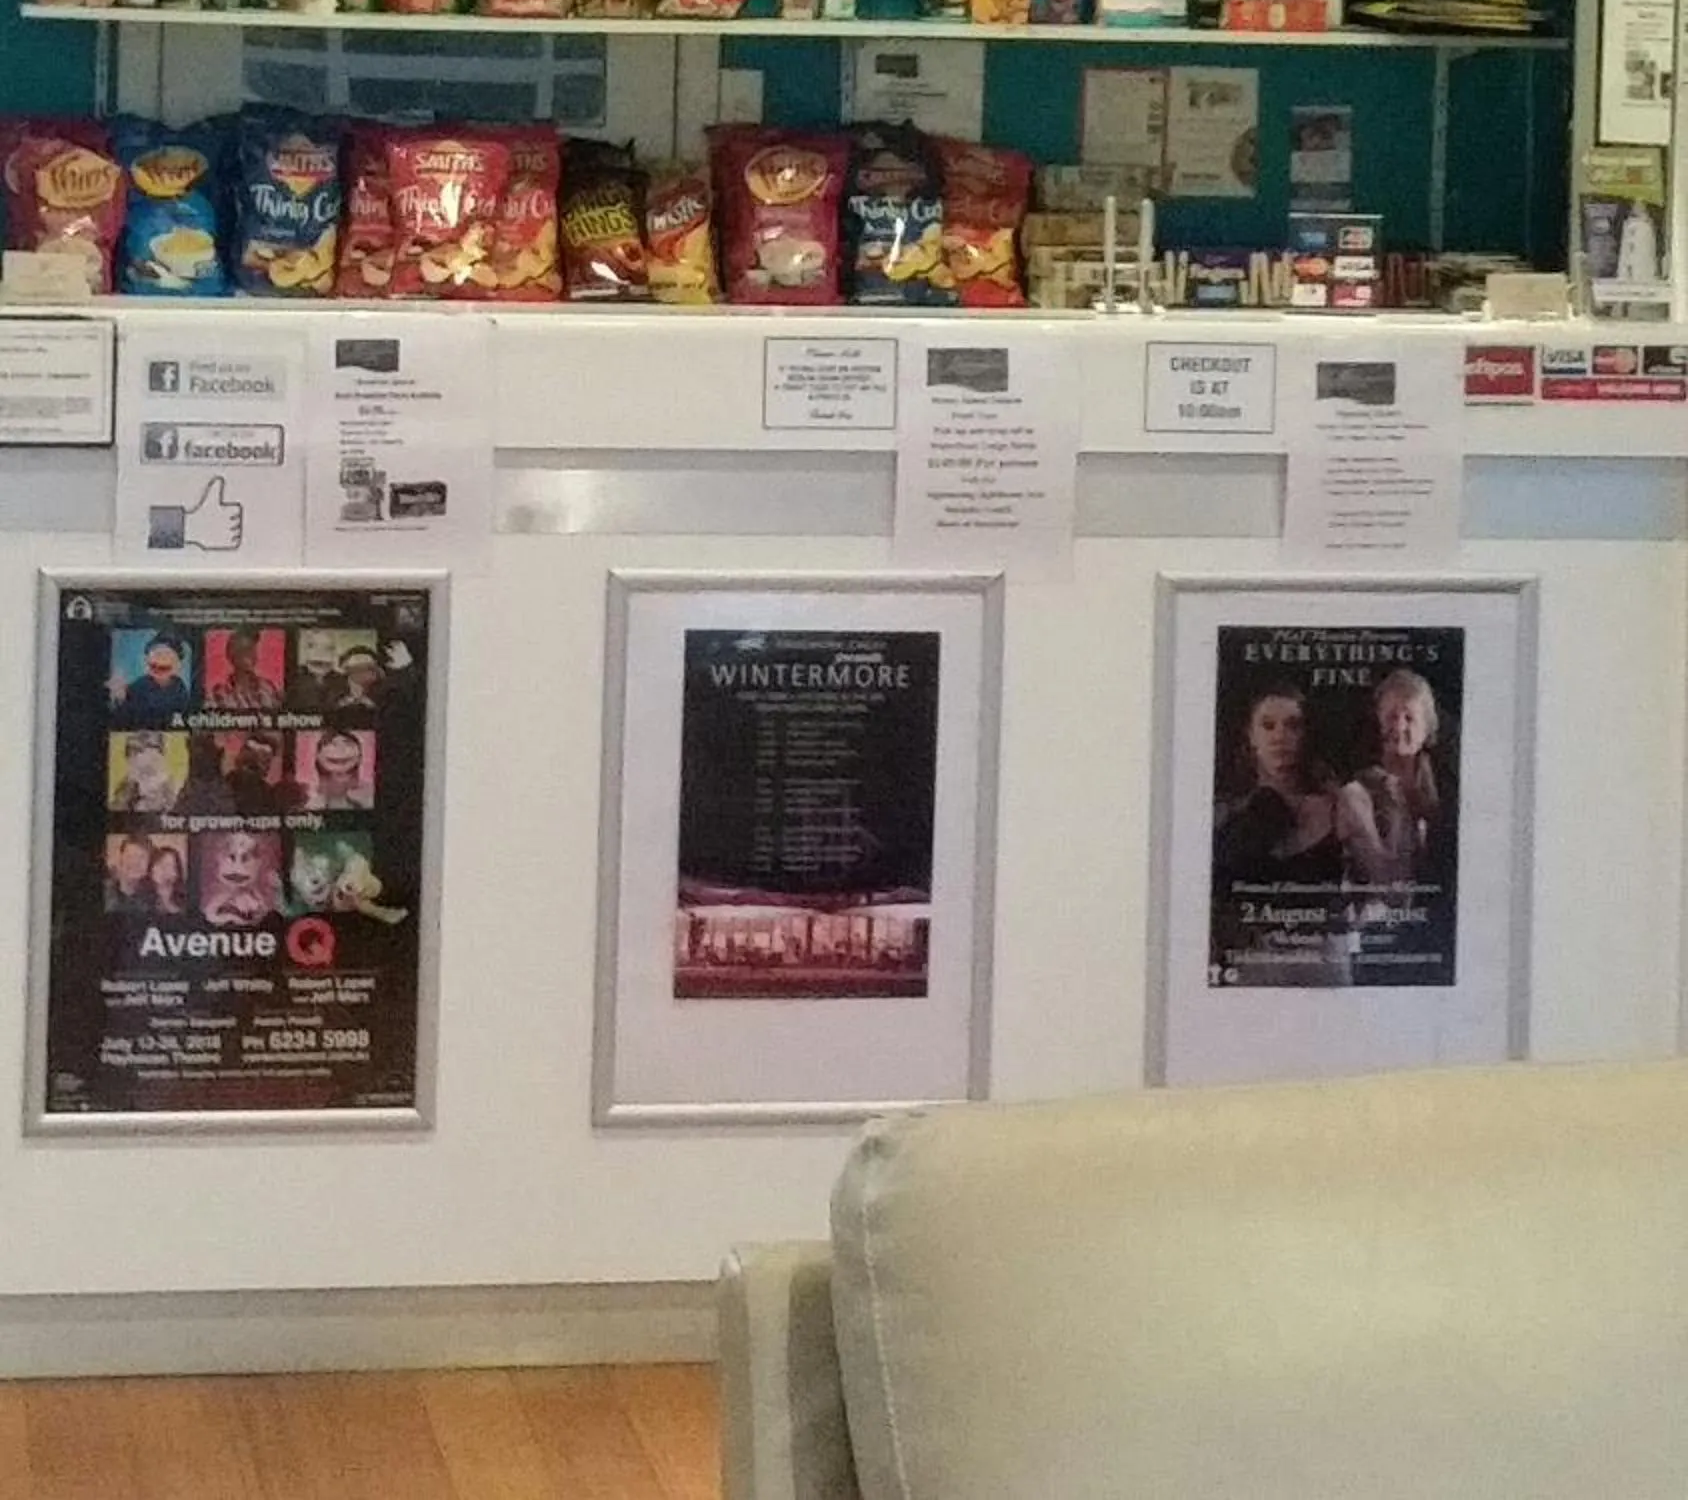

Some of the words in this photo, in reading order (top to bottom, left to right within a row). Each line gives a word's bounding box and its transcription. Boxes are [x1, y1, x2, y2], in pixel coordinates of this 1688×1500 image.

[1170, 356, 1252, 373] CHECKOUT
[188, 376, 276, 394] Facebook
[183, 441, 277, 460] facebook
[1243, 642, 1440, 662] EVERYTHING'S
[710, 663, 911, 689] WINTERMORE
[1311, 667, 1372, 687] FINE
[171, 713, 185, 727] A
[188, 712, 273, 728] children's
[277, 713, 323, 727] show
[161, 814, 186, 829] for
[189, 815, 281, 832] grown-ups
[1240, 901, 1256, 923] 2
[1260, 903, 1326, 928] August
[1361, 903, 1428, 928] August
[140, 927, 277, 957] Avenue
[286, 916, 335, 965] Q
[268, 1030, 317, 1050] 6234
